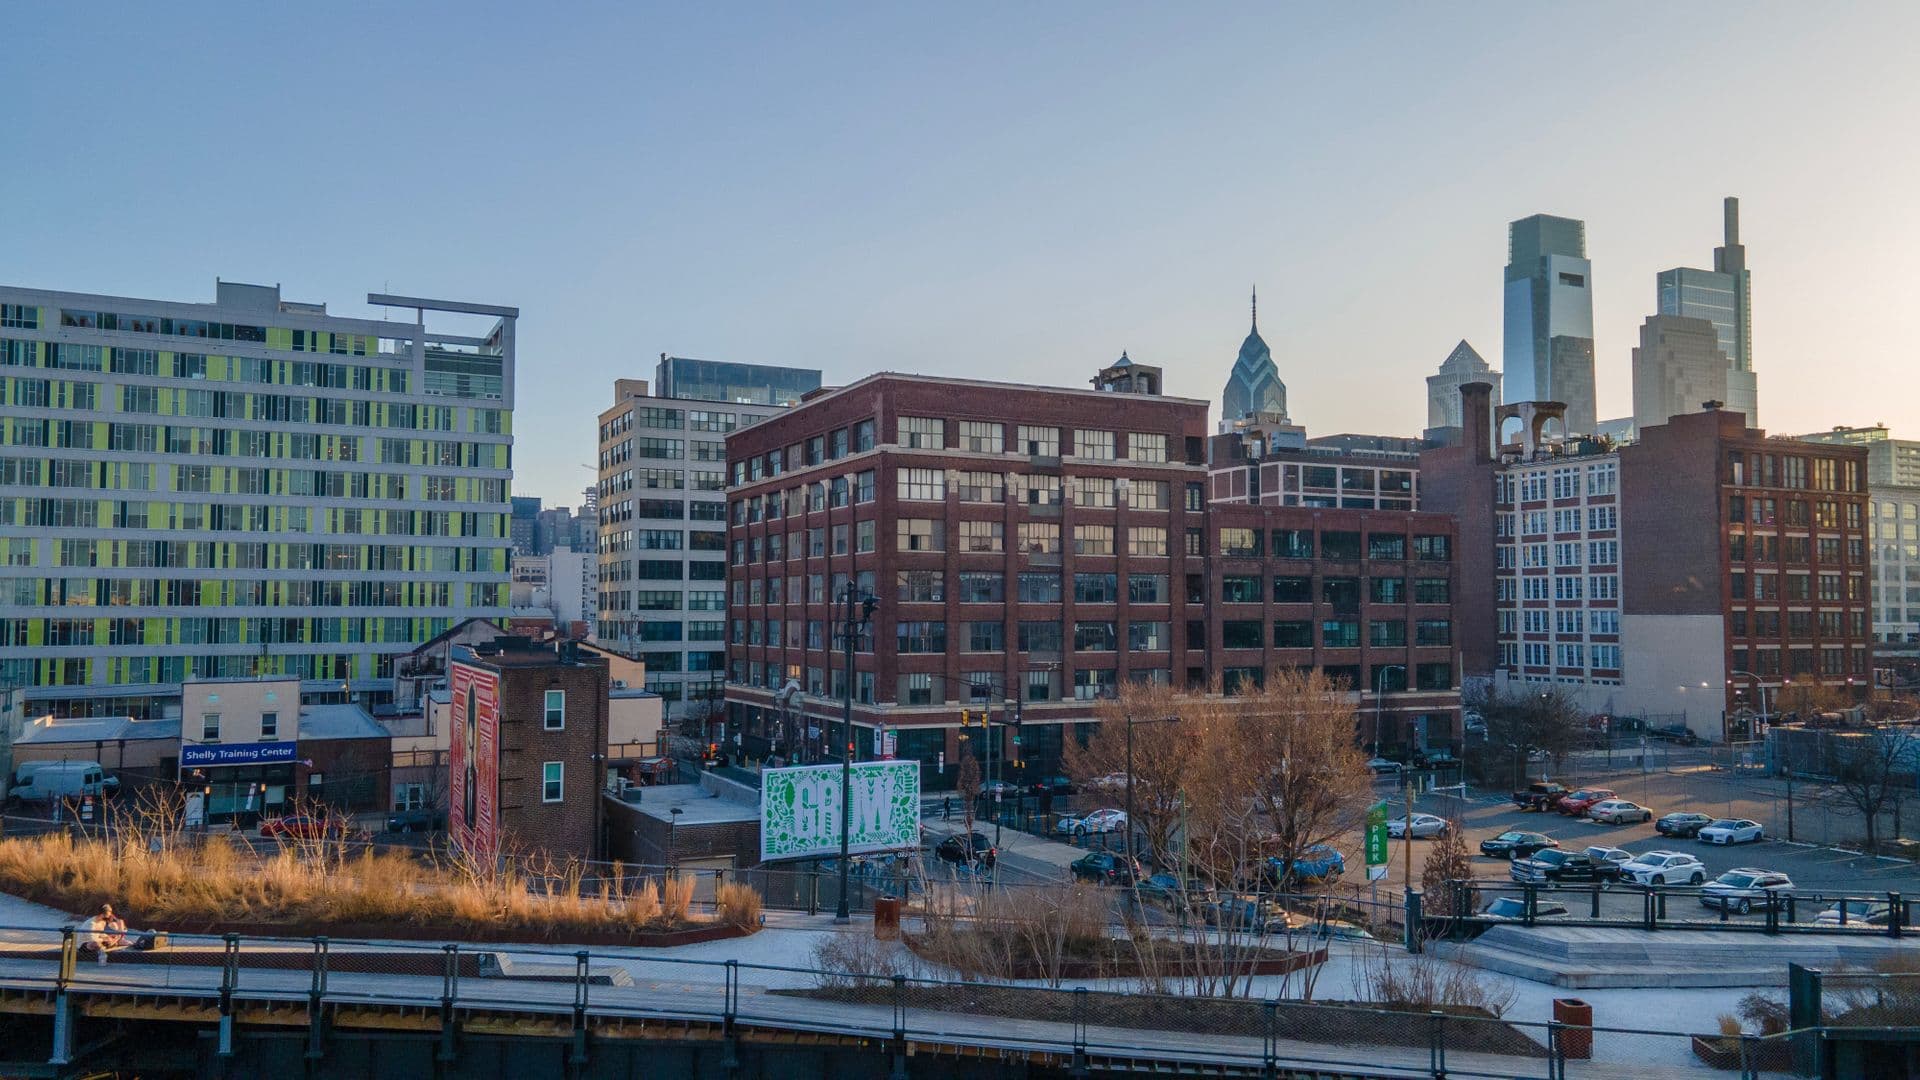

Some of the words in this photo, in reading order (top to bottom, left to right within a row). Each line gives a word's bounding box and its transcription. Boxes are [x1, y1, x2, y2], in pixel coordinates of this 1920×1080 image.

[186, 750, 217, 761] Shelly
[219, 748, 259, 759] Training
[261, 748, 293, 757] Center
